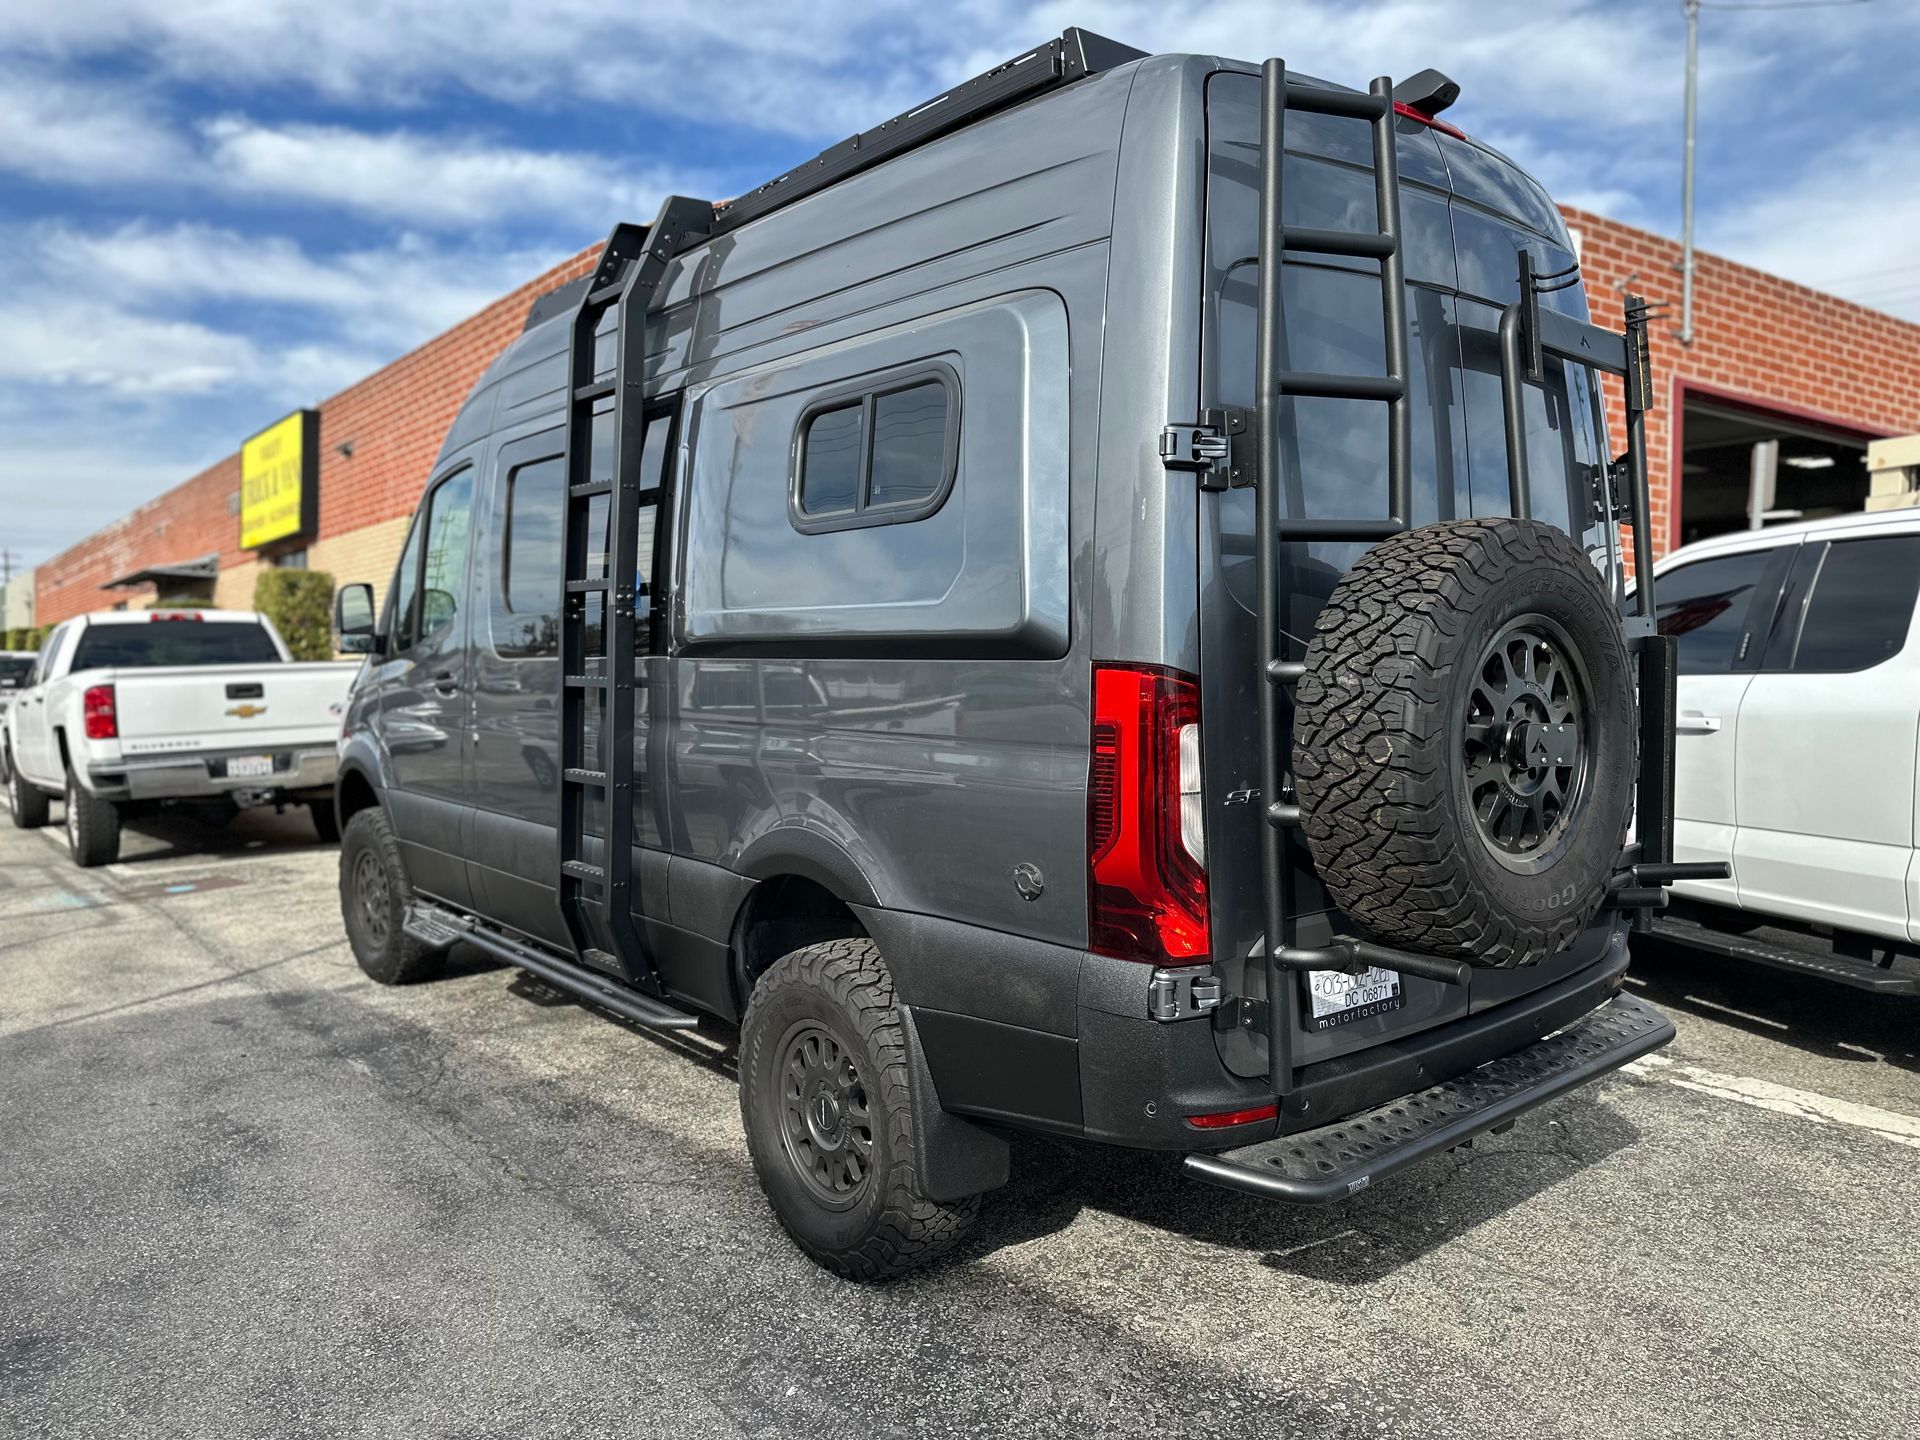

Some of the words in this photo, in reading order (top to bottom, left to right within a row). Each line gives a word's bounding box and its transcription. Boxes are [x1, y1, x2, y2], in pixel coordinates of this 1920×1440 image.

[1345, 991, 1358, 1008] DC
[1363, 984, 1388, 1003] 06871
[1319, 999, 1400, 1029] motorfactory
